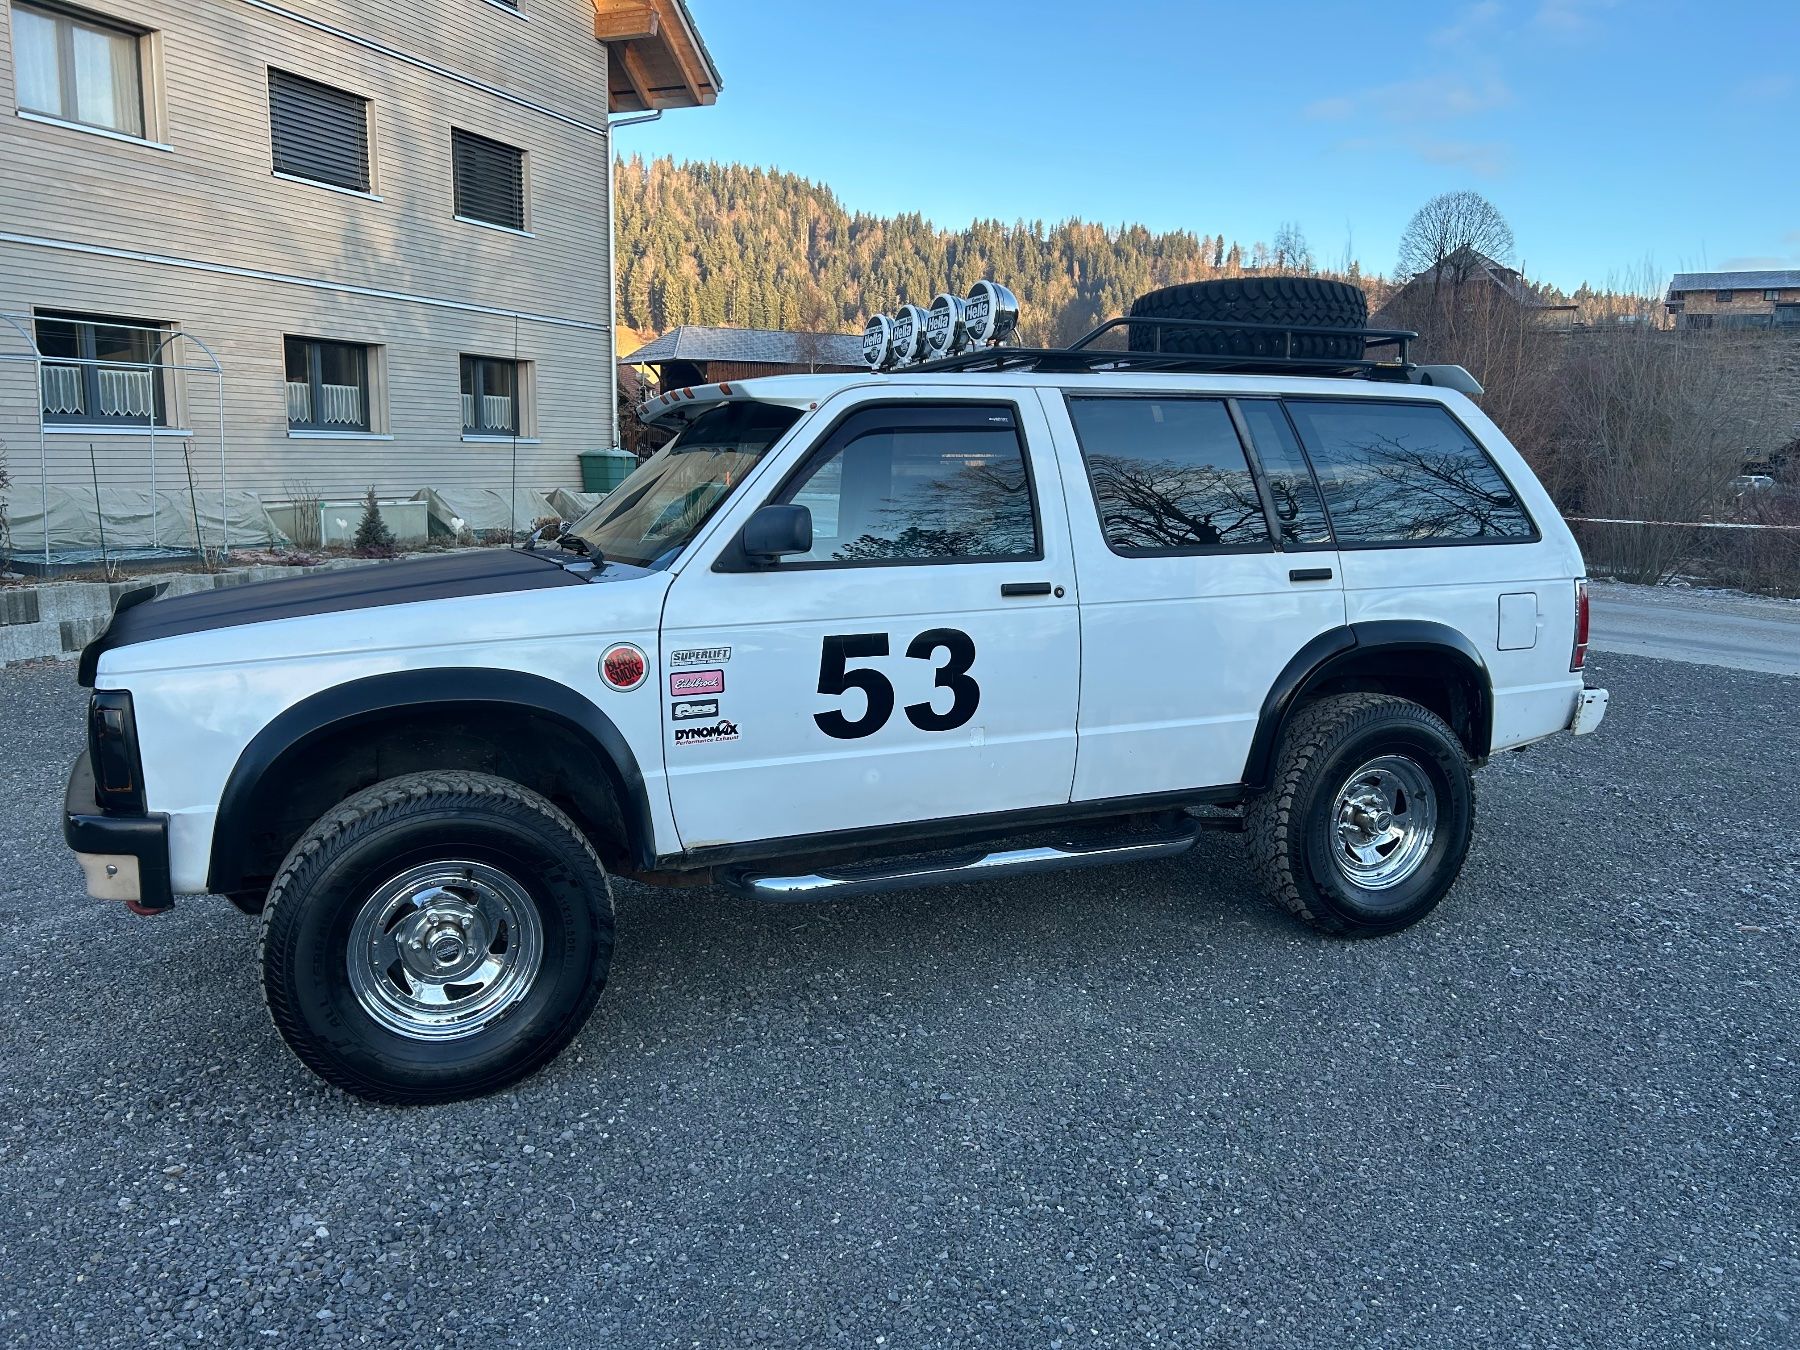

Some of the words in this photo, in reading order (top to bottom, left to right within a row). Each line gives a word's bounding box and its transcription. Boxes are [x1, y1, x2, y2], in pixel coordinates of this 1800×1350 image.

[966, 303, 988, 320] Hella
[928, 314, 949, 331] Hella
[863, 332, 882, 348] Hella
[894, 324, 912, 340] Hella
[604, 649, 638, 672] BLACK
[673, 649, 729, 661] SUPERLIFT
[610, 663, 643, 685] SMOKE
[675, 677, 720, 690] Edelbrock
[813, 628, 981, 740] 53
[675, 722, 739, 740] DYNOMAX
[676, 738, 713, 746] Performance
